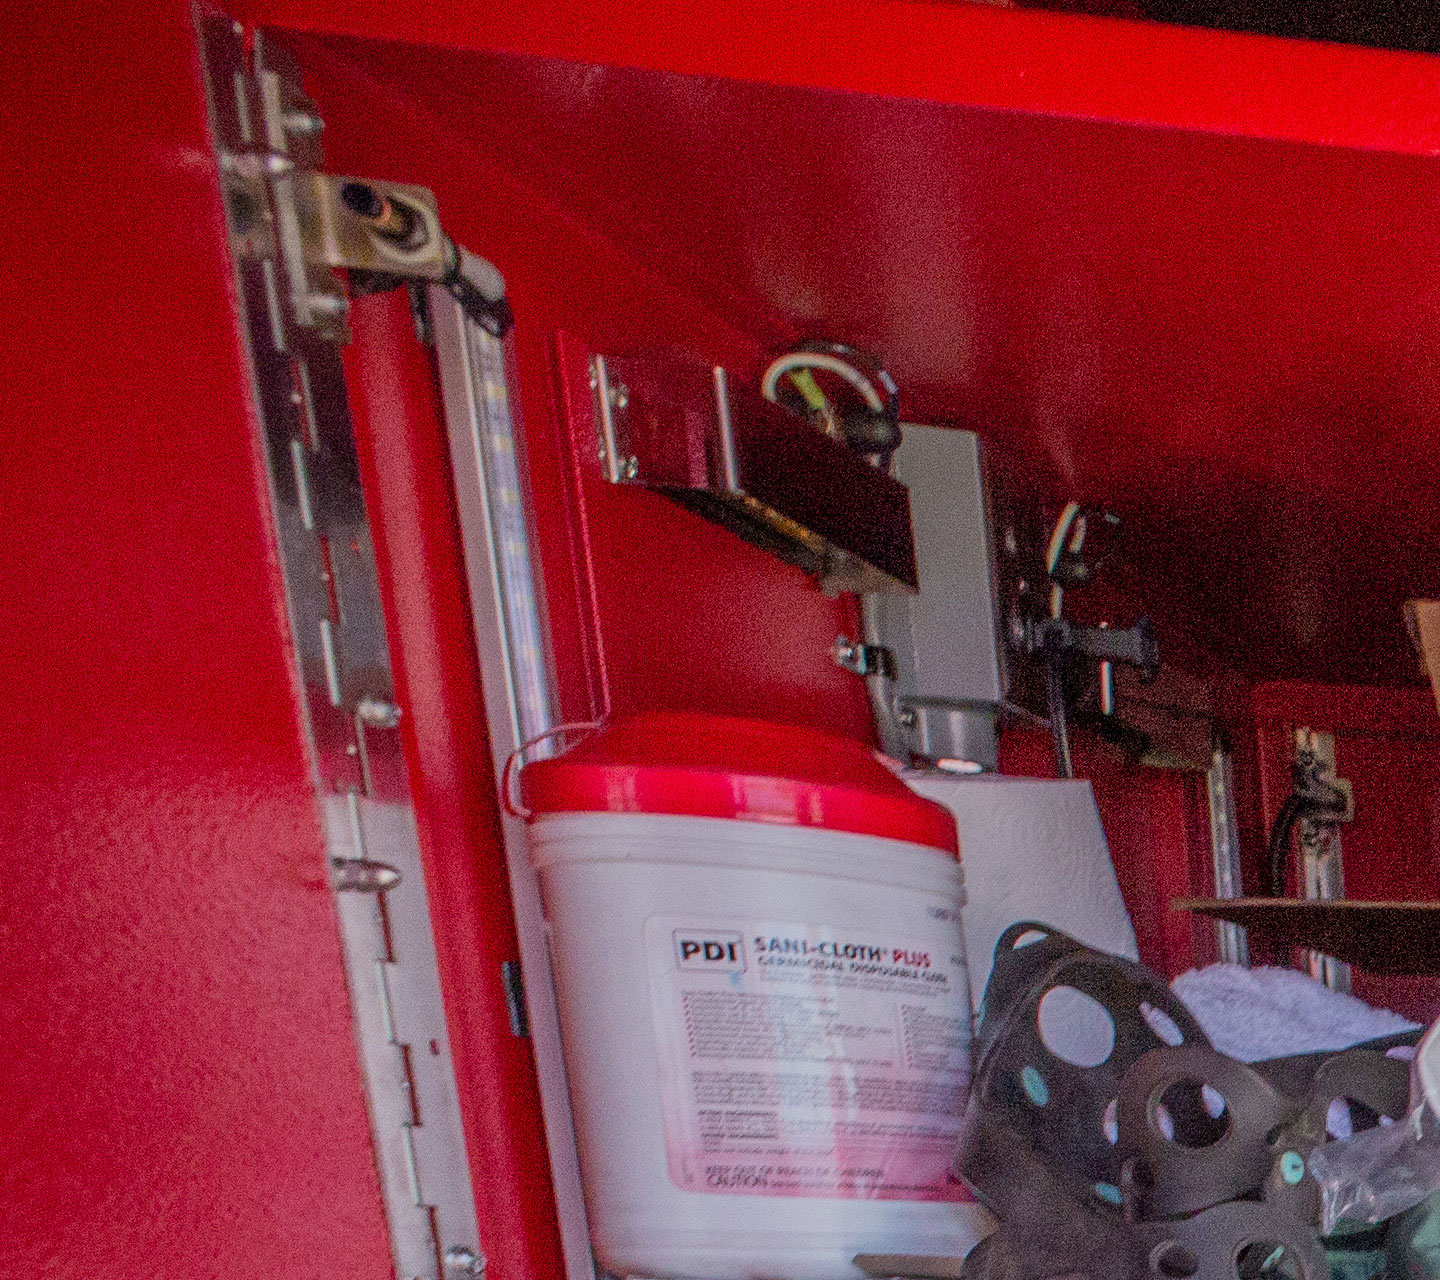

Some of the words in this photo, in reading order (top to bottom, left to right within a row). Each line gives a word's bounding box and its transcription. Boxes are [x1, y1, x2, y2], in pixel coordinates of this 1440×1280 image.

[681, 941, 738, 962] PDI
[754, 936, 882, 962] SANI-CLOTH
[893, 949, 932, 969] PLUS
